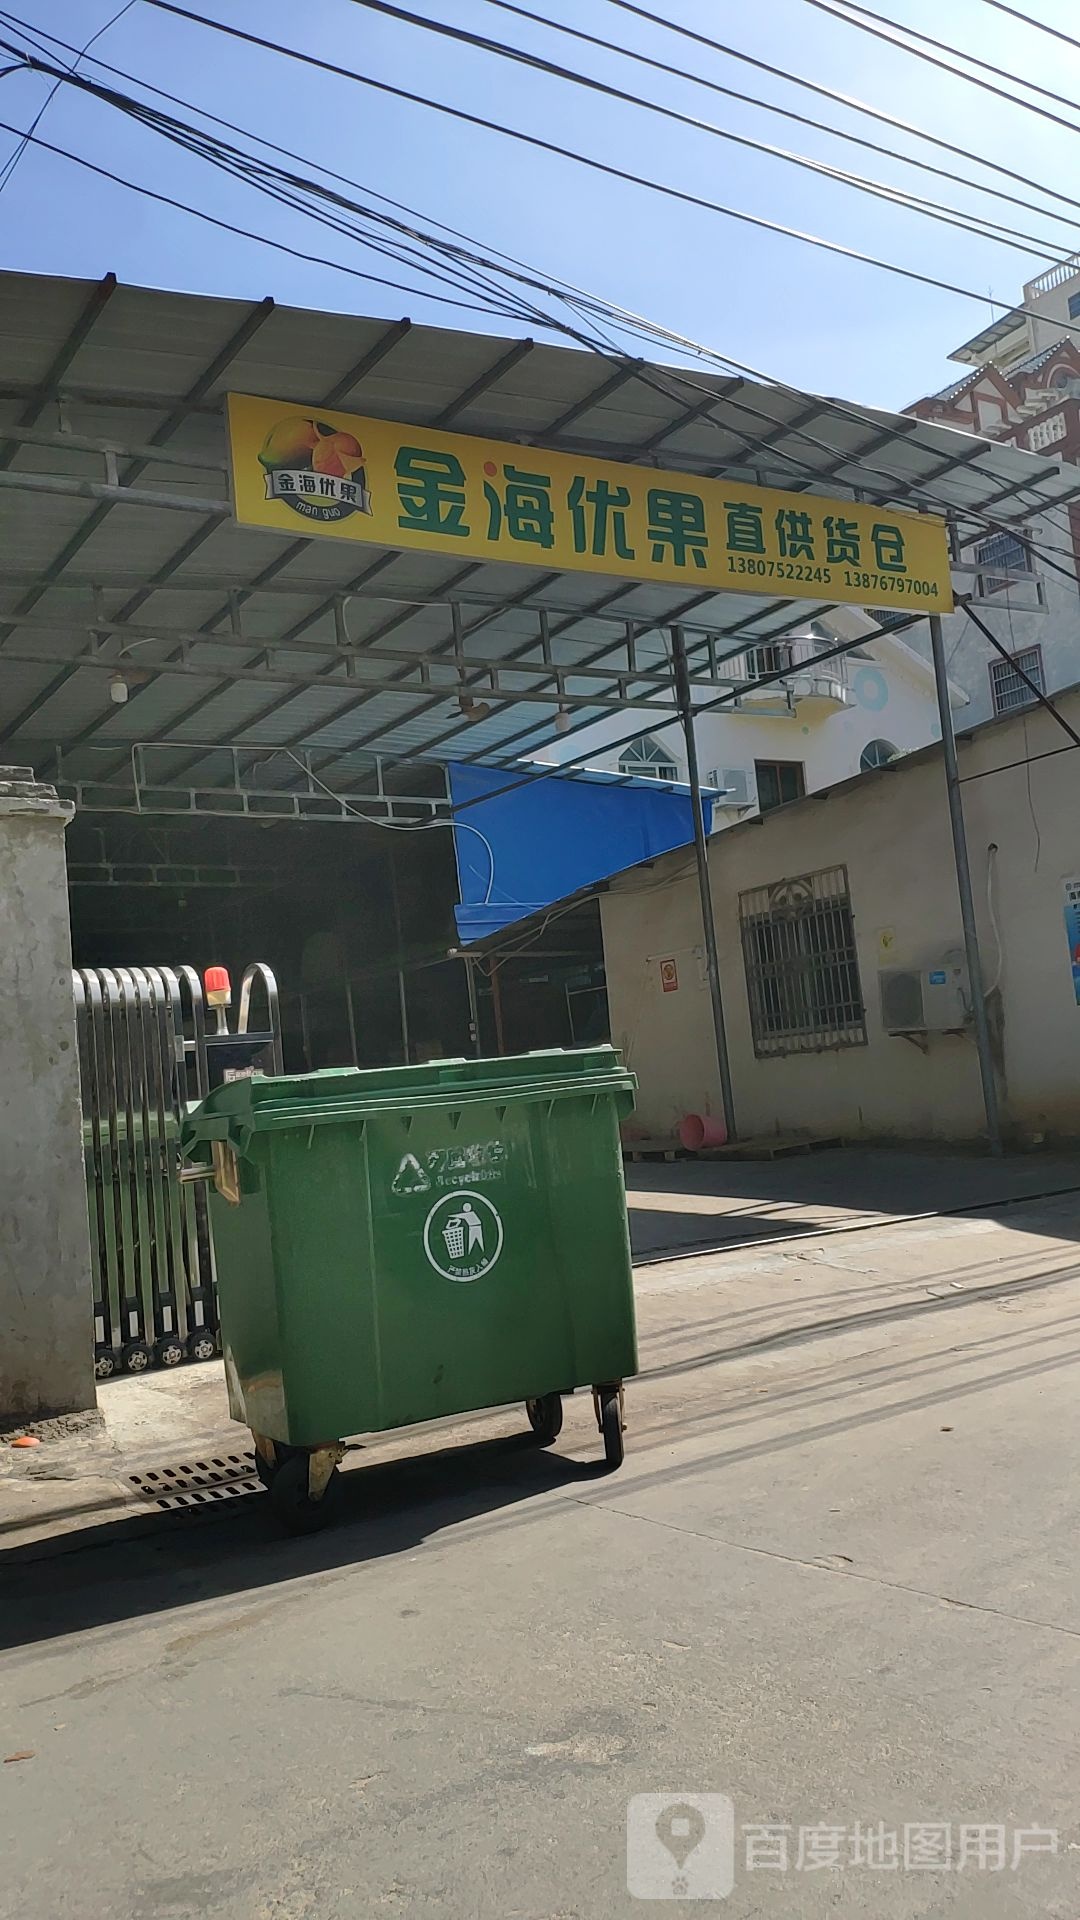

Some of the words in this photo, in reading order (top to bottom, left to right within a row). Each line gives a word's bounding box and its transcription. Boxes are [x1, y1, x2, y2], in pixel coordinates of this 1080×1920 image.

[278, 473, 357, 503] 金海优果
[296, 501, 318, 516] man
[322, 507, 341, 520] guo
[394, 446, 709, 568] 金海优果
[727, 556, 832, 584] 13807522245
[844, 571, 939, 597] 13876797004
